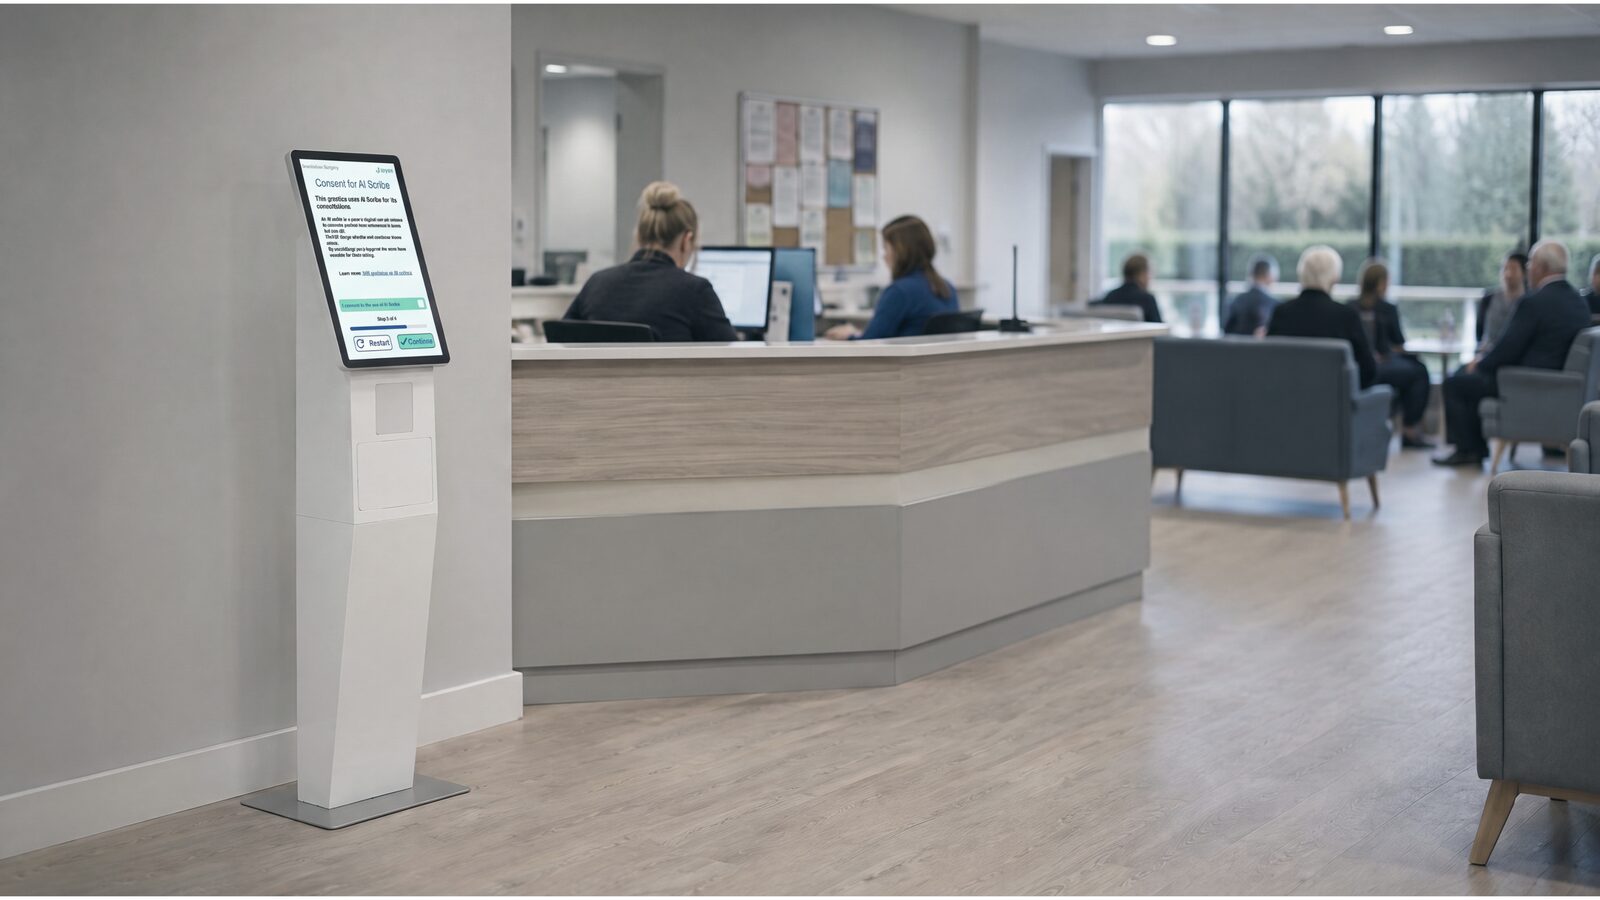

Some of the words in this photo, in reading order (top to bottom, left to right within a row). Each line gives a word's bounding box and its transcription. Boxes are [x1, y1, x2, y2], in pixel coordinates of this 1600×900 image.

[315, 178, 346, 188] Consent
[347, 179, 357, 188] for
[358, 180, 367, 189] AI
[368, 180, 390, 189] Scribe
[369, 339, 390, 347] Restart
